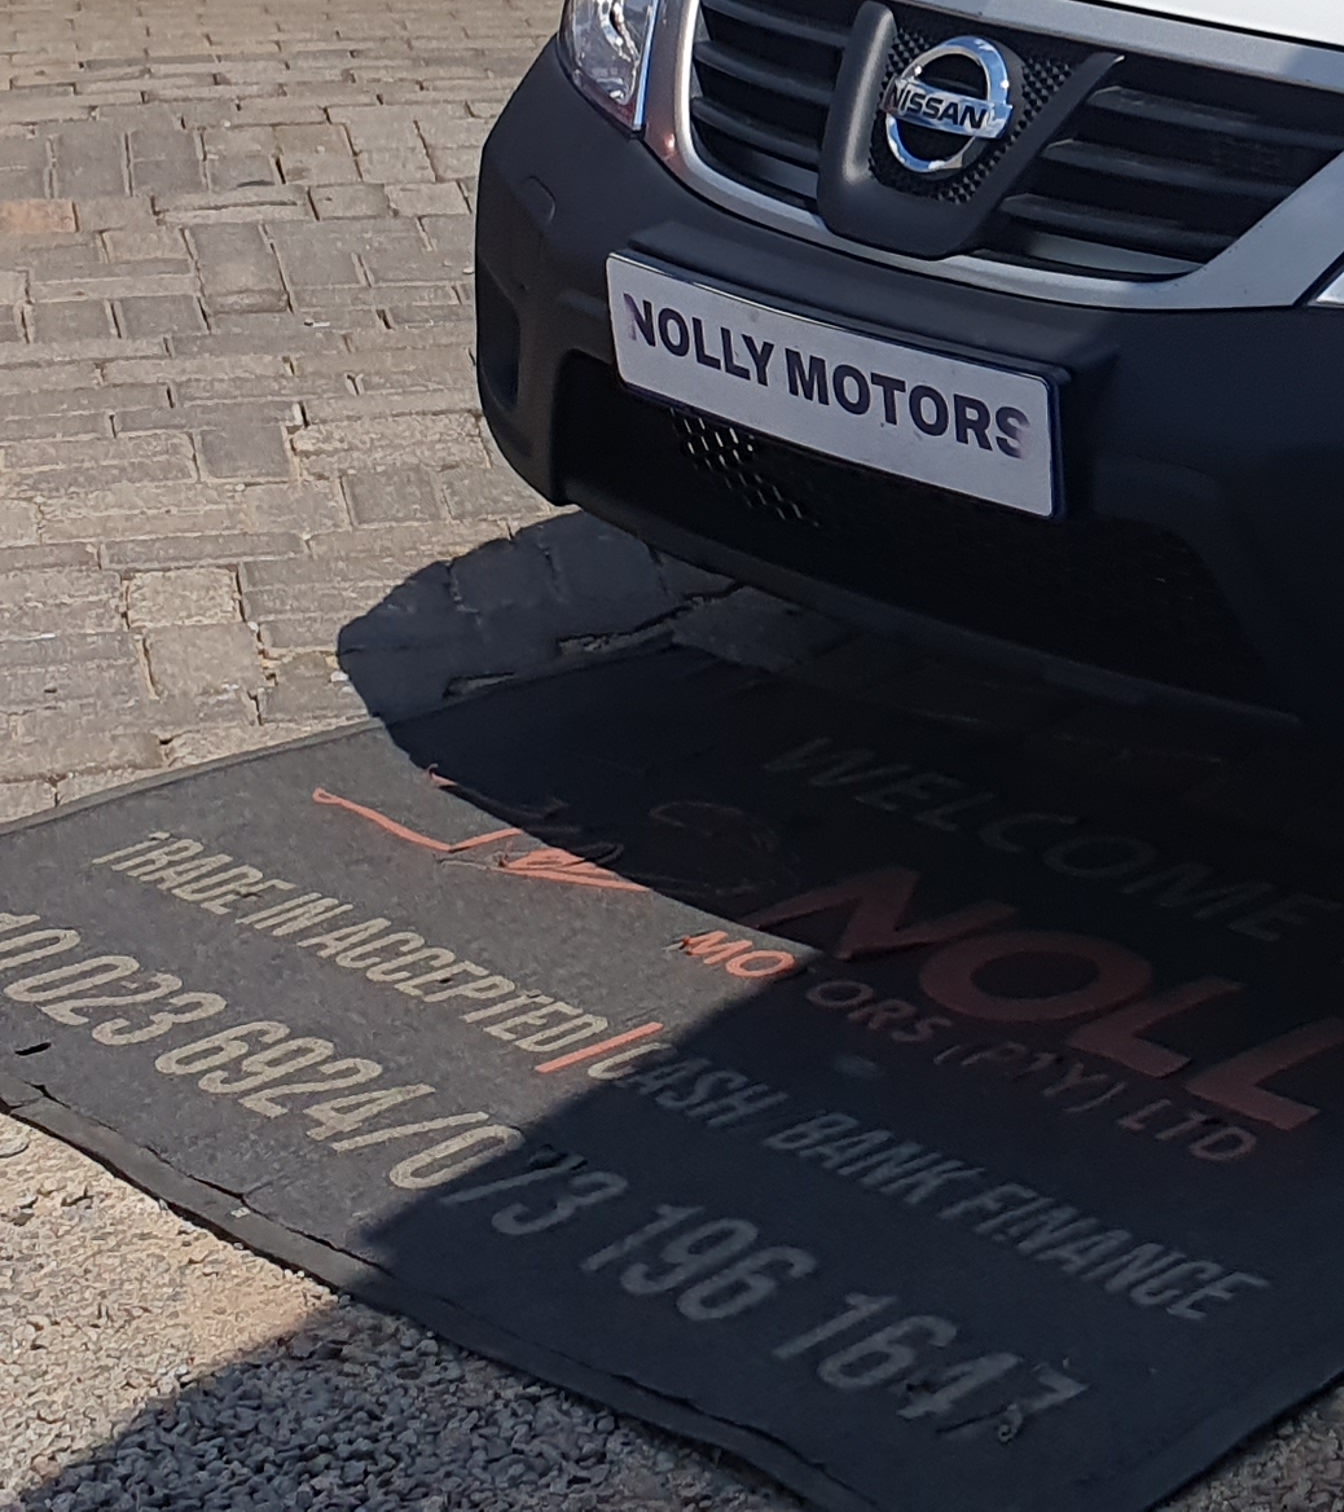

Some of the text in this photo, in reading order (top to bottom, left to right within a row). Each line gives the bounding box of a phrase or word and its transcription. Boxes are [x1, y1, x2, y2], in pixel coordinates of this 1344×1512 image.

[885, 81, 988, 130] NISSAN
[623, 293, 1030, 459] NOLLY MOTORS
[763, 735, 1344, 943] WELCOME
[2, 955, 228, 1046] 023
[578, 1202, 818, 1321] 196
[92, 830, 295, 915] TRADE
[235, 892, 354, 936] IN
[761, 1109, 986, 1204] BANK
[937, 1182, 1272, 1320] FINANCE
[682, 929, 954, 1043] MOORS
[1116, 1098, 1257, 1162] LTD
